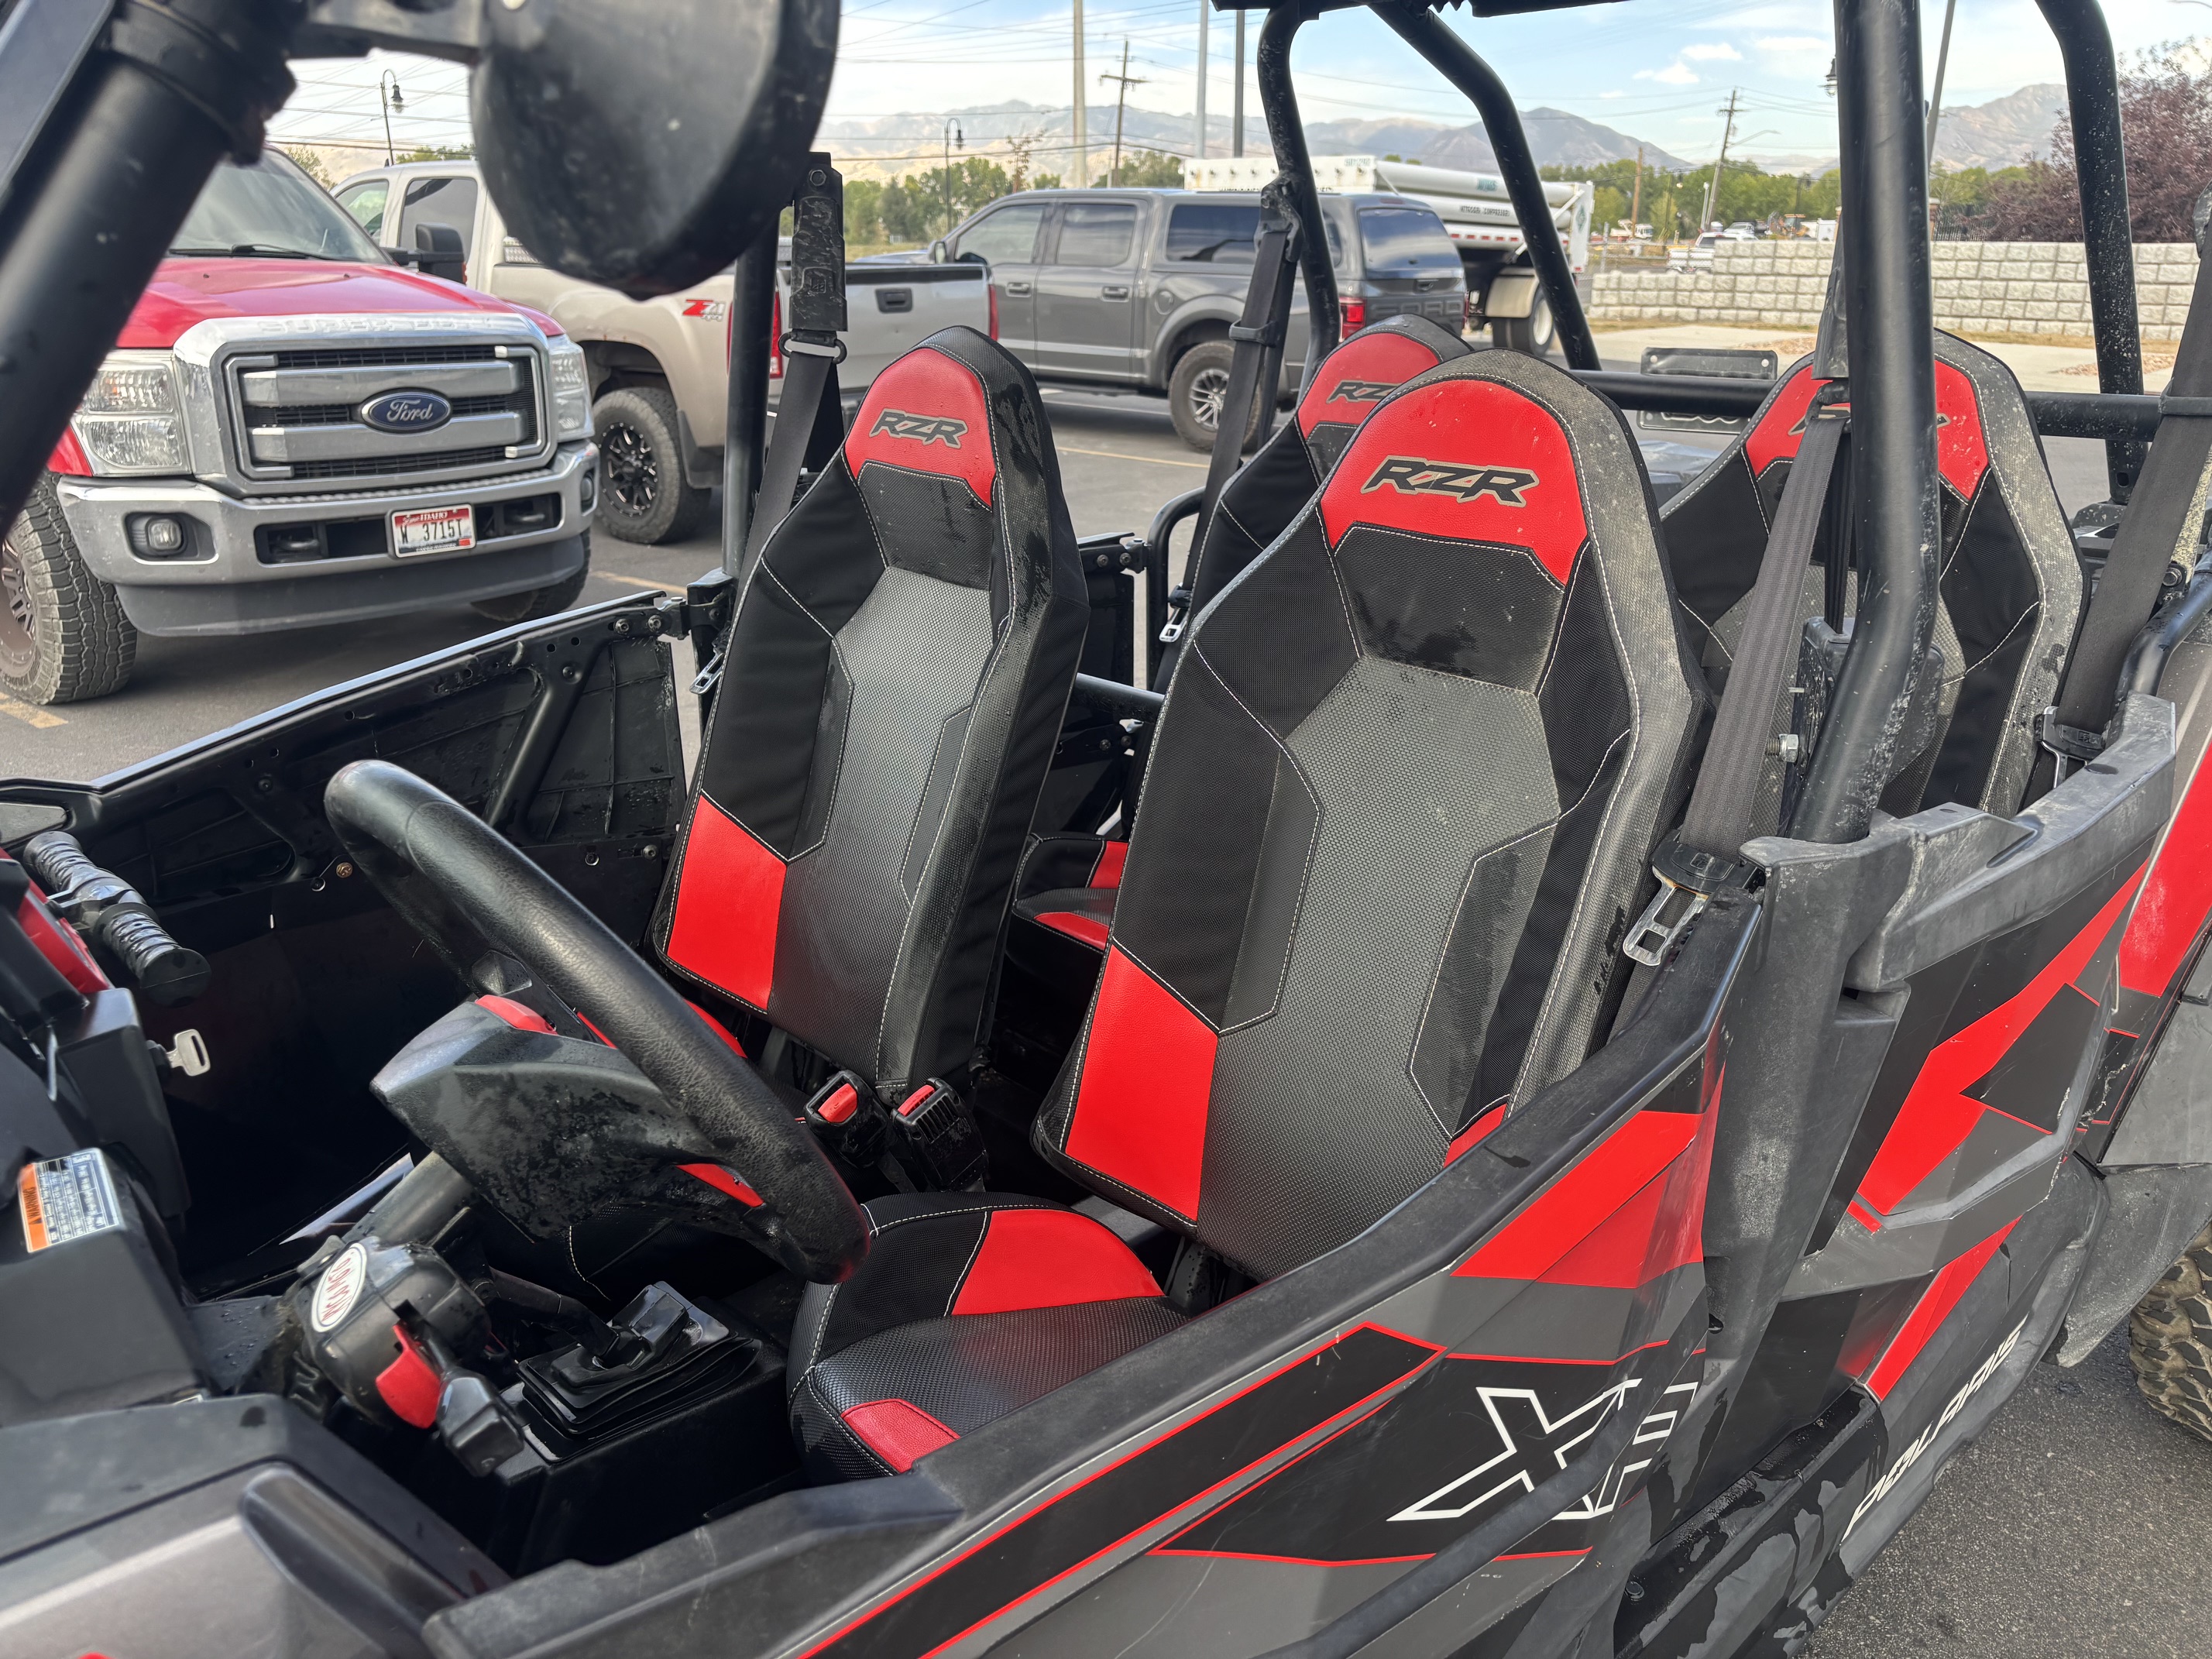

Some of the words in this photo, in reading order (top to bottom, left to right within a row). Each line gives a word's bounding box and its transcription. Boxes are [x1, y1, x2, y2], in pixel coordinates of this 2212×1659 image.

[1326, 380, 1401, 404] RZ
[386, 399, 433, 422] Ford
[869, 408, 968, 449] RZR
[1361, 455, 1540, 507] RZR
[420, 511, 448, 521] IDAHO
[422, 518, 462, 541] 3715T
[22, 1187, 41, 1220] WARNING
[1839, 1313, 2029, 1542] POLARIS
